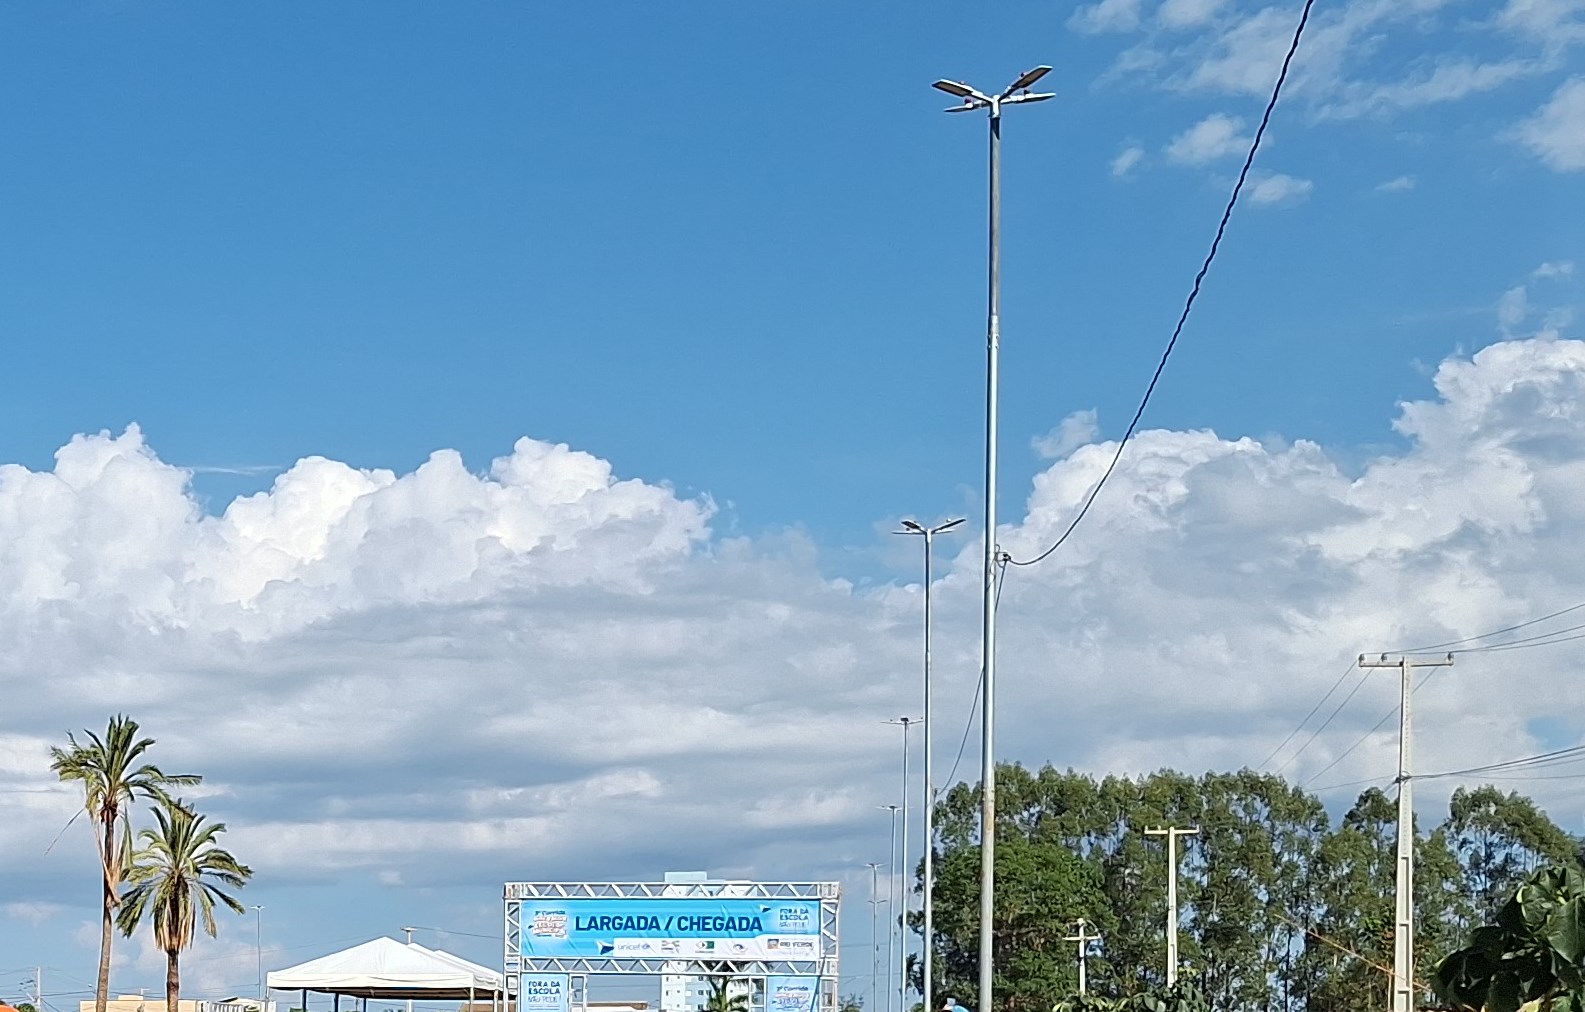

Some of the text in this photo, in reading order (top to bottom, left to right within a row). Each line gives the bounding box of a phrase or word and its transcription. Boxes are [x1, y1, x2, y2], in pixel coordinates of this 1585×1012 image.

[575, 915, 661, 931] LARGADA
[663, 915, 674, 931] /
[677, 915, 763, 932] CHEGADA
